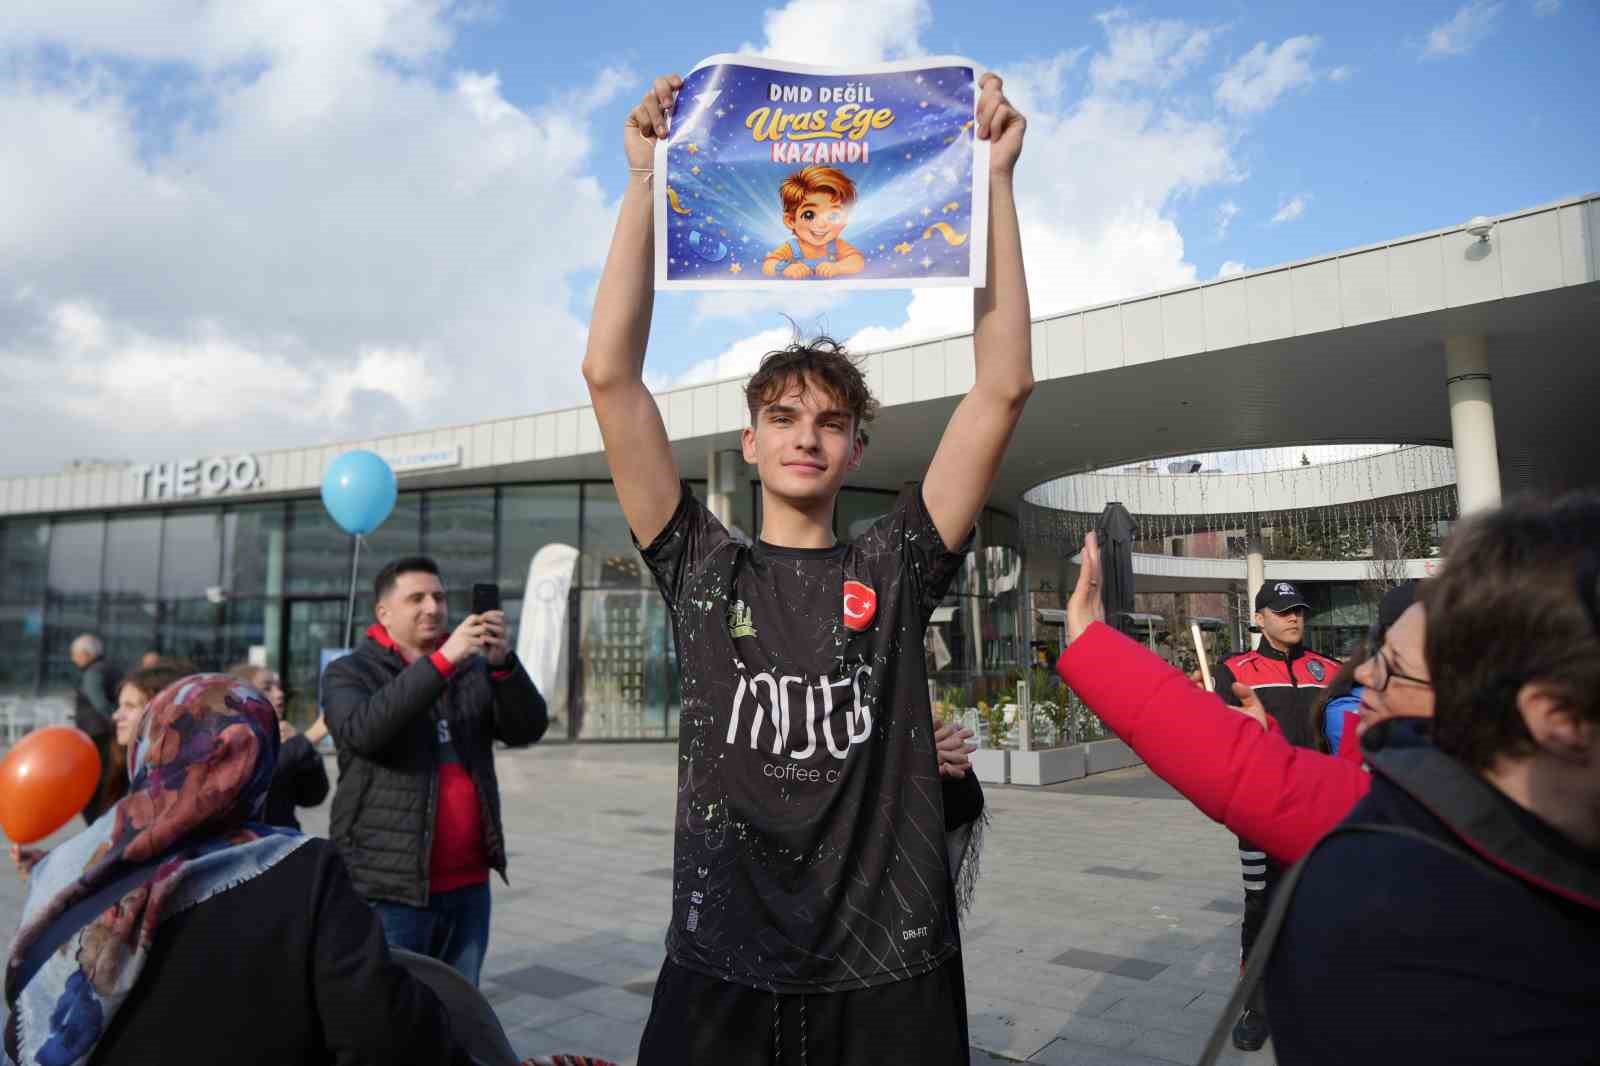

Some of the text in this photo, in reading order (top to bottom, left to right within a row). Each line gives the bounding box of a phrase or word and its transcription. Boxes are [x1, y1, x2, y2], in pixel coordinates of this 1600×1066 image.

[769, 83, 875, 103] DMD DEĞİL
[745, 103, 896, 141] Uras Ege
[770, 141, 869, 164] KAZANDI
[131, 461, 200, 499] THE
[763, 763, 820, 782] coffee
[902, 926, 928, 940] DRI-FIT
